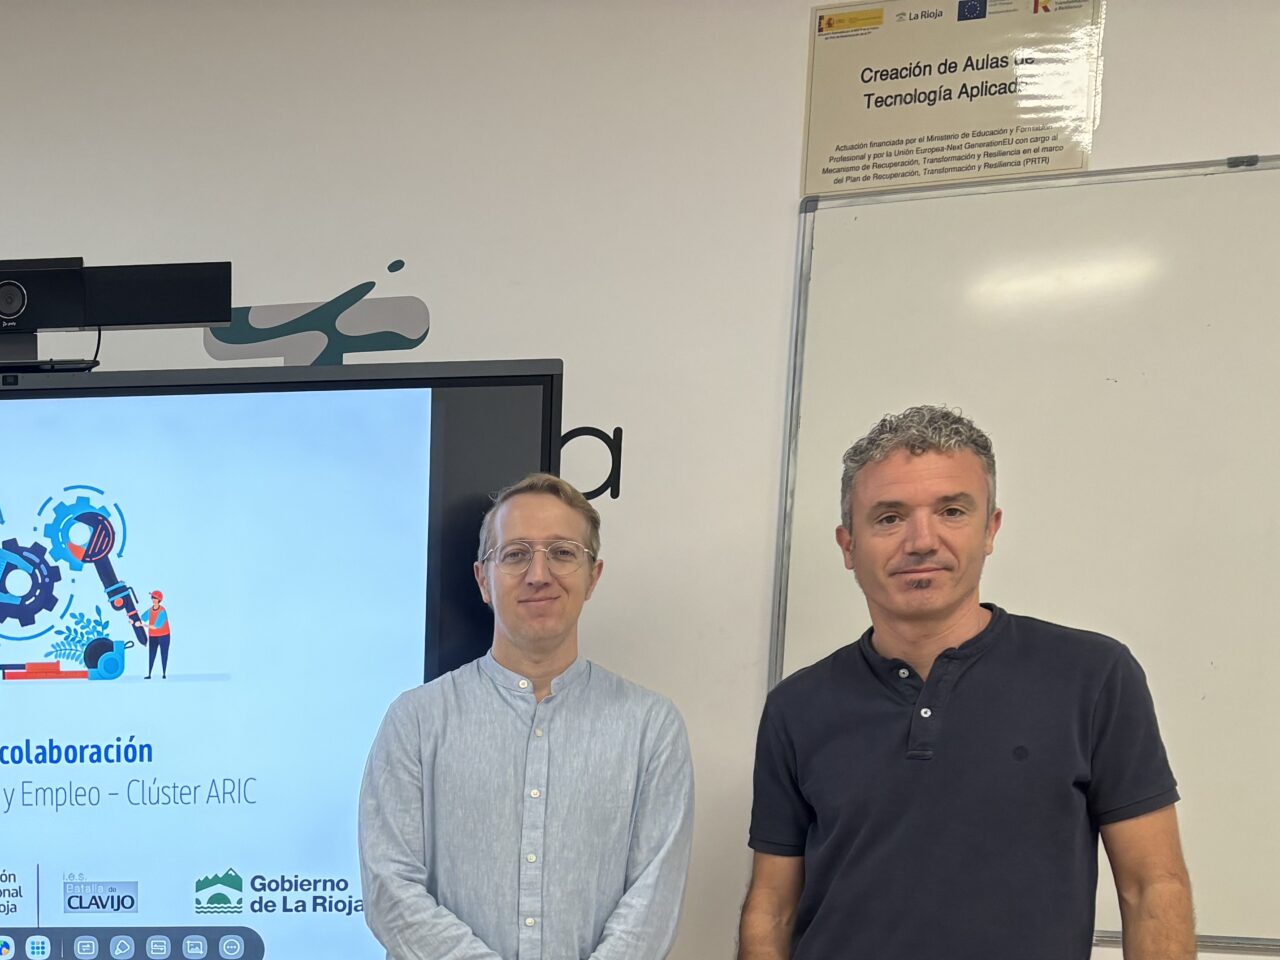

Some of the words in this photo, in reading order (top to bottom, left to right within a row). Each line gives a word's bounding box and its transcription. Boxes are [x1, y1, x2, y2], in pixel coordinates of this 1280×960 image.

[909, 12, 919, 20] La
[920, 9, 943, 20] Rioja
[860, 61, 932, 83] Creación
[937, 59, 958, 75] de
[962, 54, 1009, 72] Aulas
[864, 85, 953, 109] Tecnología
[828, 153, 867, 163] Profesional
[872, 151, 885, 160] por
[894, 148, 914, 157] Unión
[964, 137, 1014, 150] GenerationEU
[1029, 135, 1050, 144] cargo
[835, 143, 868, 152] Actuación
[869, 139, 904, 148] financiada
[905, 138, 917, 146] por
[927, 134, 959, 142] Ministerio
[971, 127, 1008, 138] Educación
[821, 165, 860, 175] Mecanismo
[871, 158, 921, 169] Recuperación,
[922, 152, 976, 164] Transformación
[983, 148, 1021, 159] Resiliencia
[845, 175, 861, 183] Plan
[872, 169, 921, 180] Recuperación,
[922, 164, 976, 176] Transformación
[983, 160, 1022, 170] Resiliencia
[1022, 156, 1050, 167] (PRTR)
[0, 735, 153, 764] colaboración
[3, 787, 15, 813] y
[21, 781, 100, 813] Empleo
[127, 778, 201, 806] Clúster
[206, 777, 257, 804] ARIC
[250, 875, 349, 893] Gobierno
[67, 894, 135, 912] CLAVIJO
[250, 897, 277, 913] de
[282, 897, 307, 912] La
[312, 896, 365, 916] Rioja
